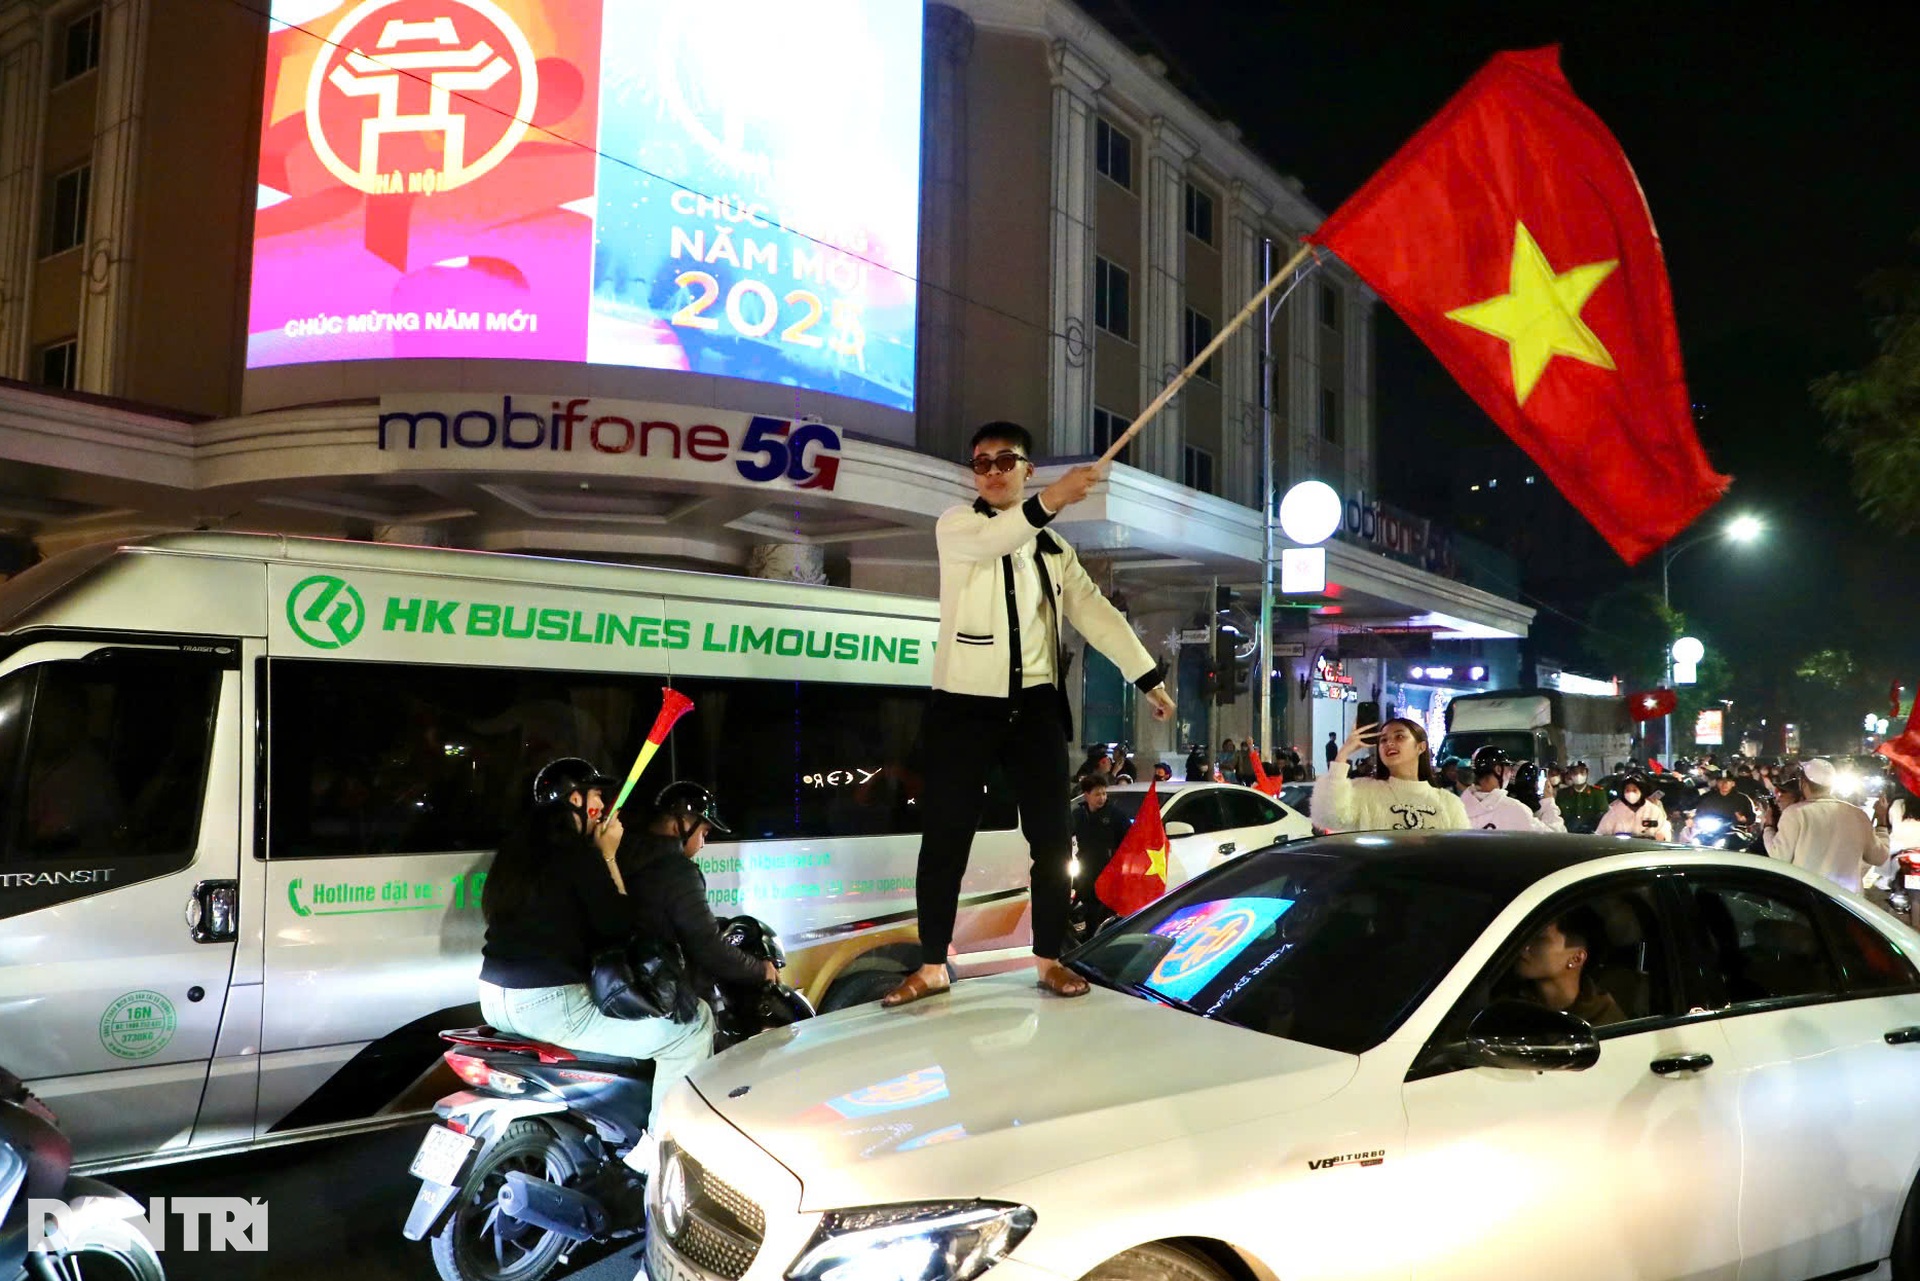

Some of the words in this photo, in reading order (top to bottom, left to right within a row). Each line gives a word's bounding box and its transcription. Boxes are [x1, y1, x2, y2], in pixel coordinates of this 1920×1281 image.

[671, 224, 778, 275] NĂM
[285, 313, 343, 337] CHÚC
[347, 310, 420, 332] MỪNG
[425, 309, 480, 330] NĂM
[486, 309, 538, 332] MỚI
[379, 395, 730, 462] mobifone
[735, 415, 841, 491] 5G
[382, 596, 457, 634] HK
[464, 602, 692, 650] BUSLINES
[703, 621, 920, 666] LIMOUSINE
[0, 868, 116, 887] TRANSIT
[313, 882, 376, 904] Hotline
[127, 1005, 152, 1020] 16N
[1308, 1158, 1334, 1170] V8
[1333, 1149, 1385, 1162] BITURBO
